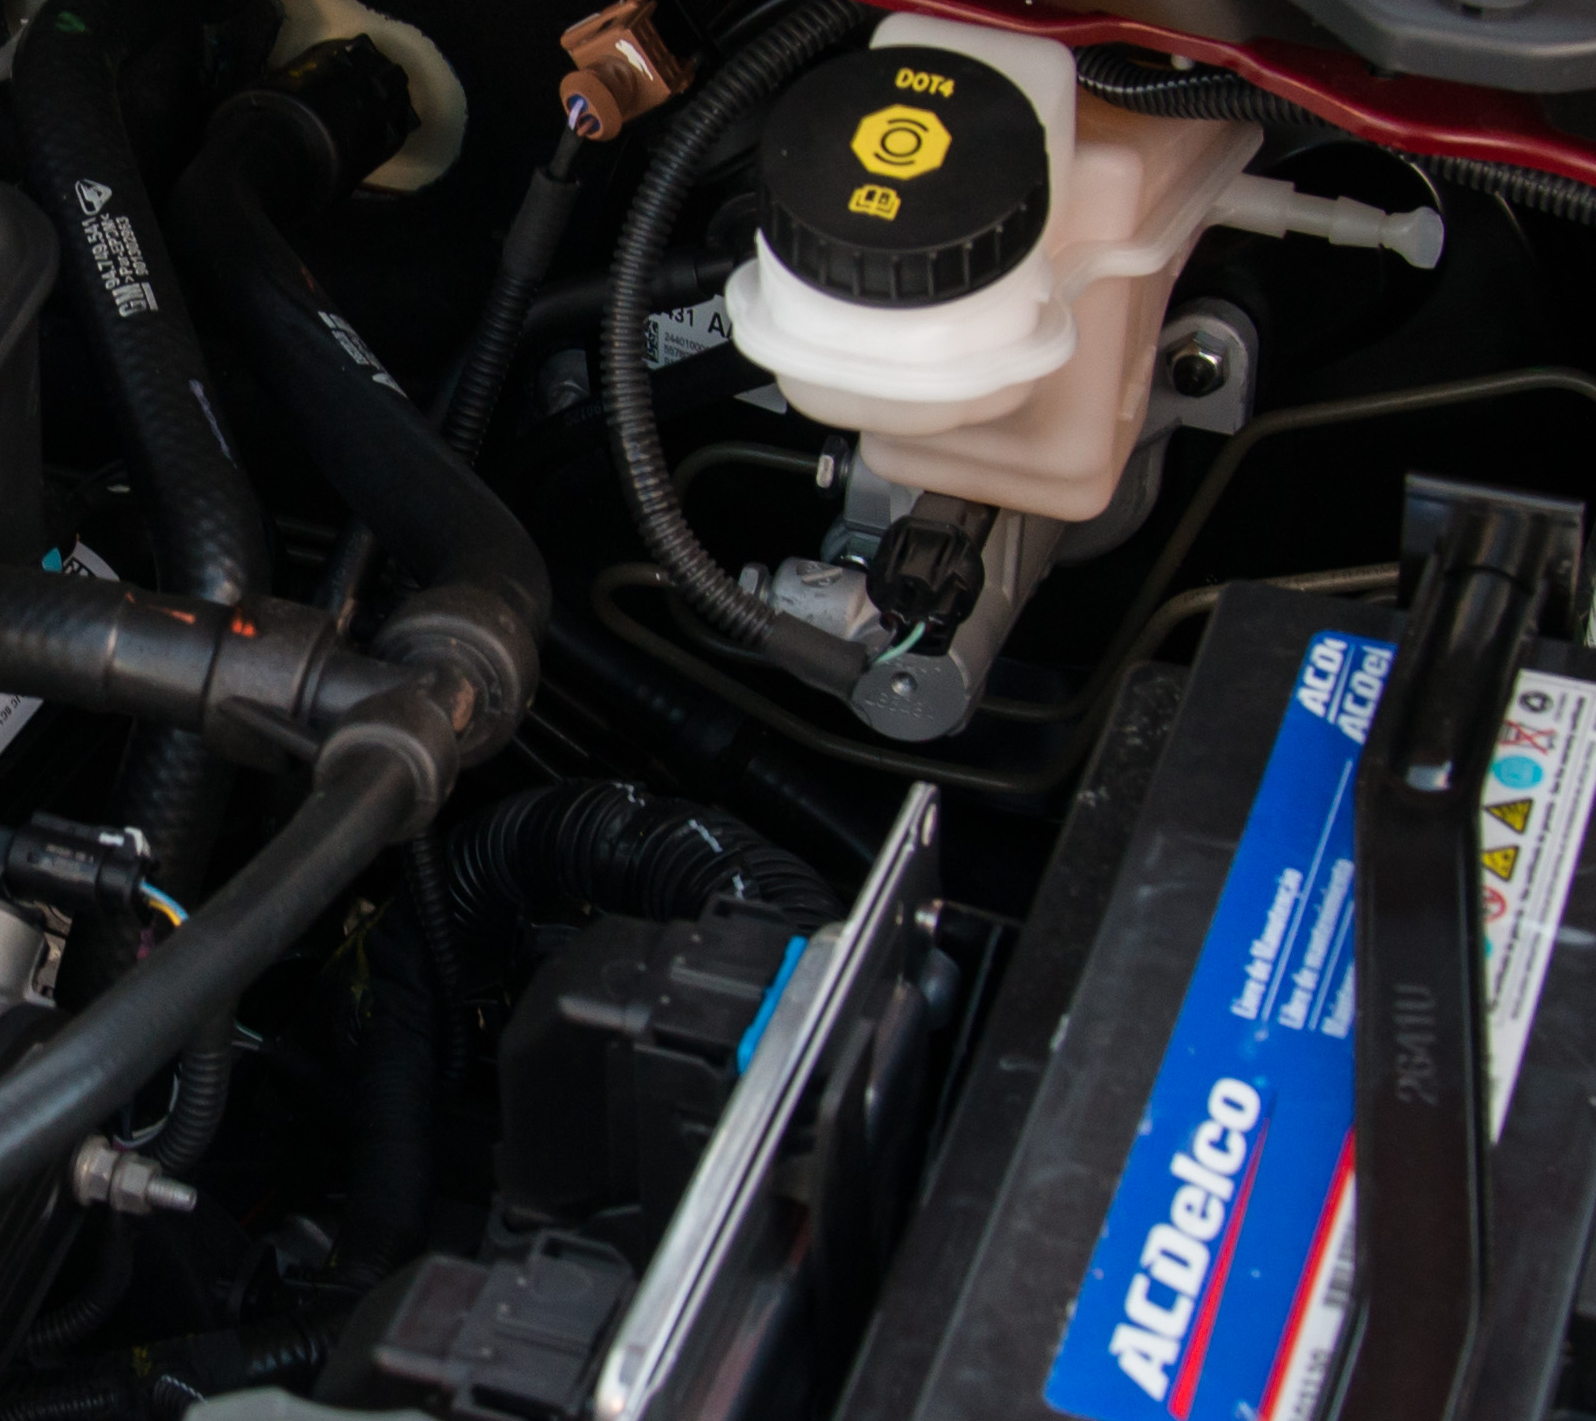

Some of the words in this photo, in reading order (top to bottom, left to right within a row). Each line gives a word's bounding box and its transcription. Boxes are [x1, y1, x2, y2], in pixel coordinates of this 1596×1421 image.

[896, 67, 957, 100] DOT4
[112, 283, 148, 317] GM
[1117, 1076, 1263, 1401] ACDelco
